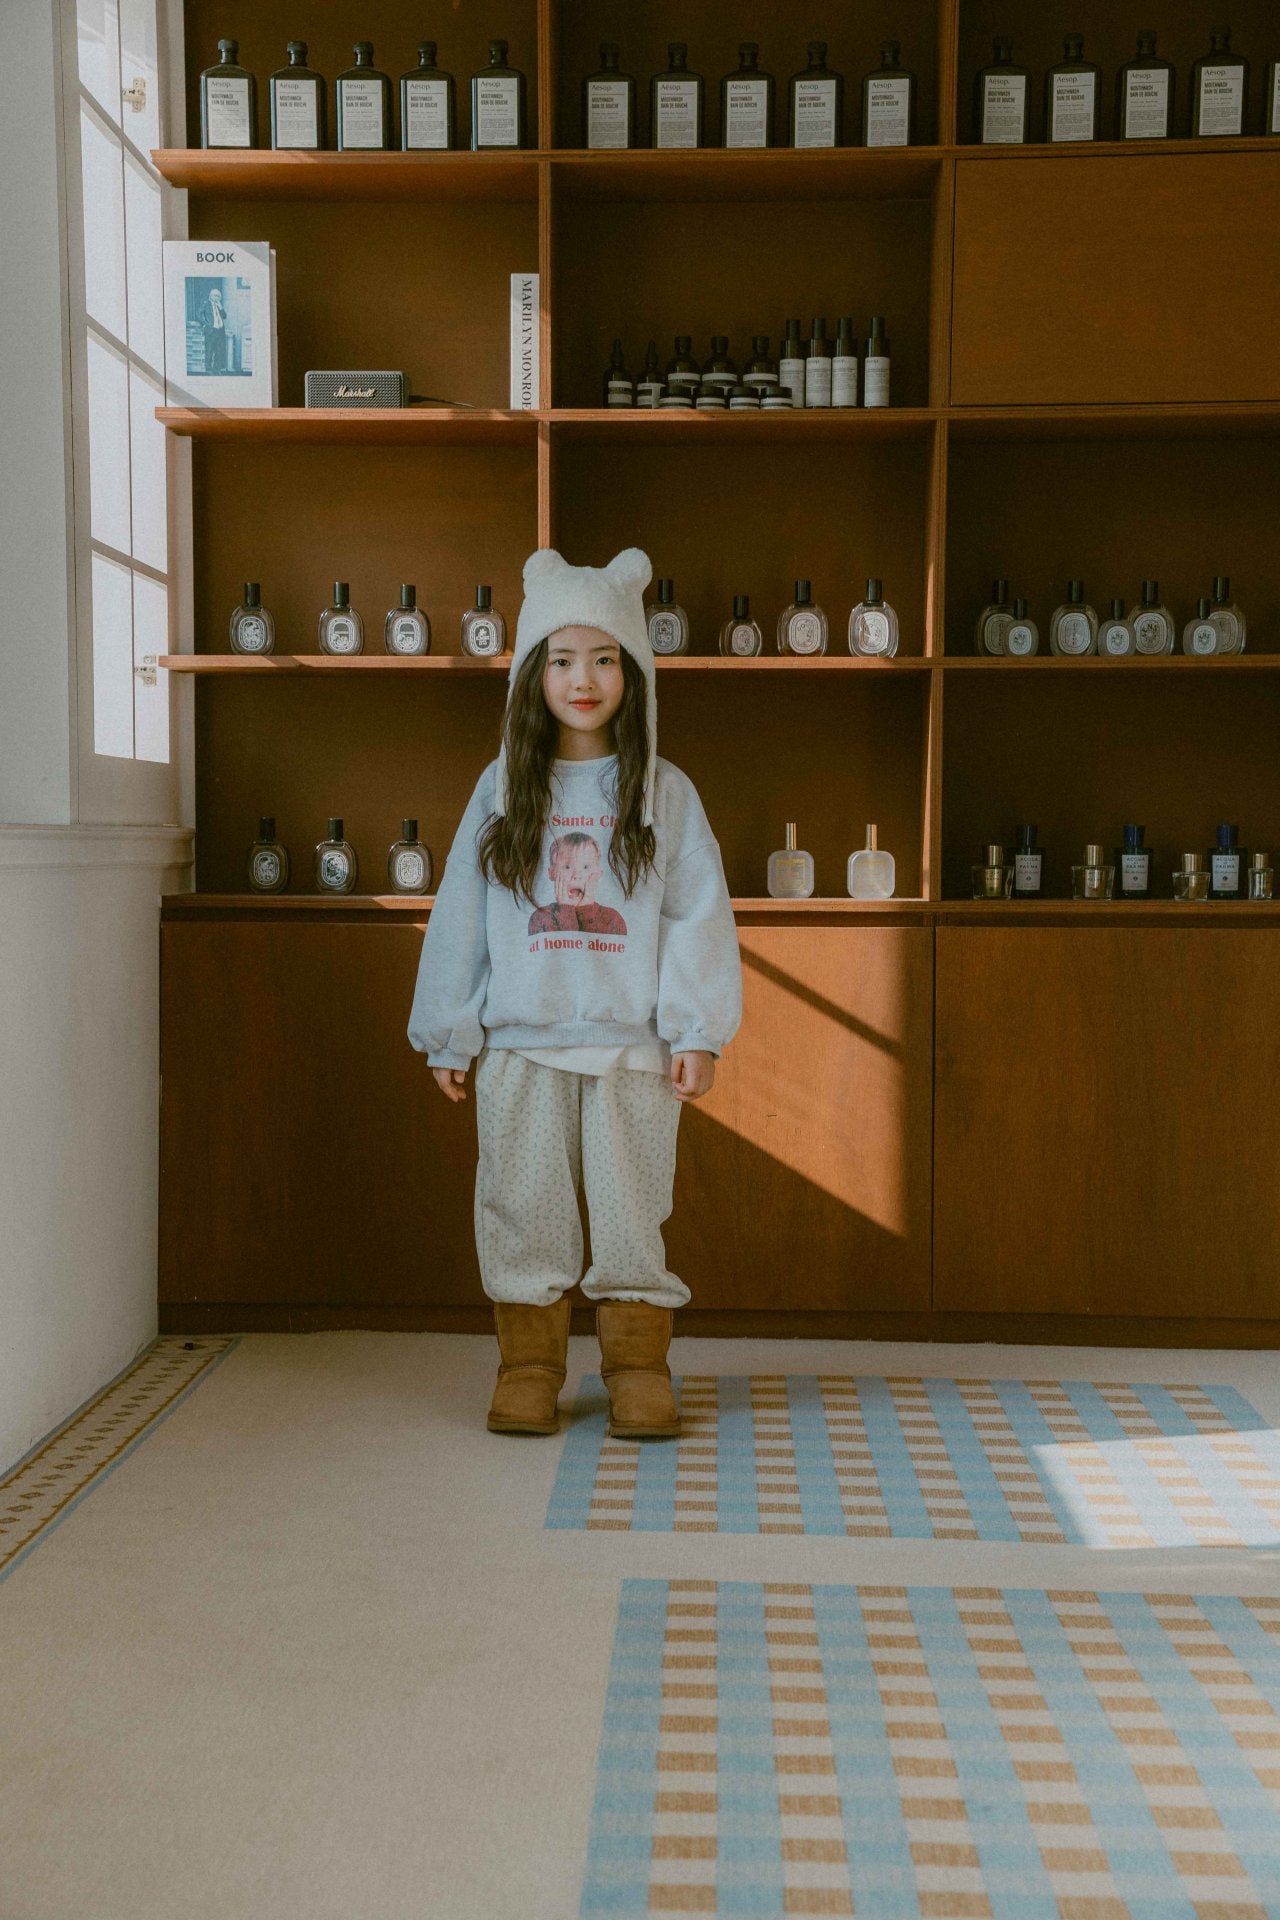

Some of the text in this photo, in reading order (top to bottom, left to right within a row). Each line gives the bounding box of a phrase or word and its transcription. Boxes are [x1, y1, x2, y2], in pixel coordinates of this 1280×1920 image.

[196, 252, 235, 263] BOOK
[522, 280, 532, 345] MARILYN
[333, 385, 376, 398] Marshall
[552, 815, 594, 827] Santa
[529, 938, 625, 953] at home alone
